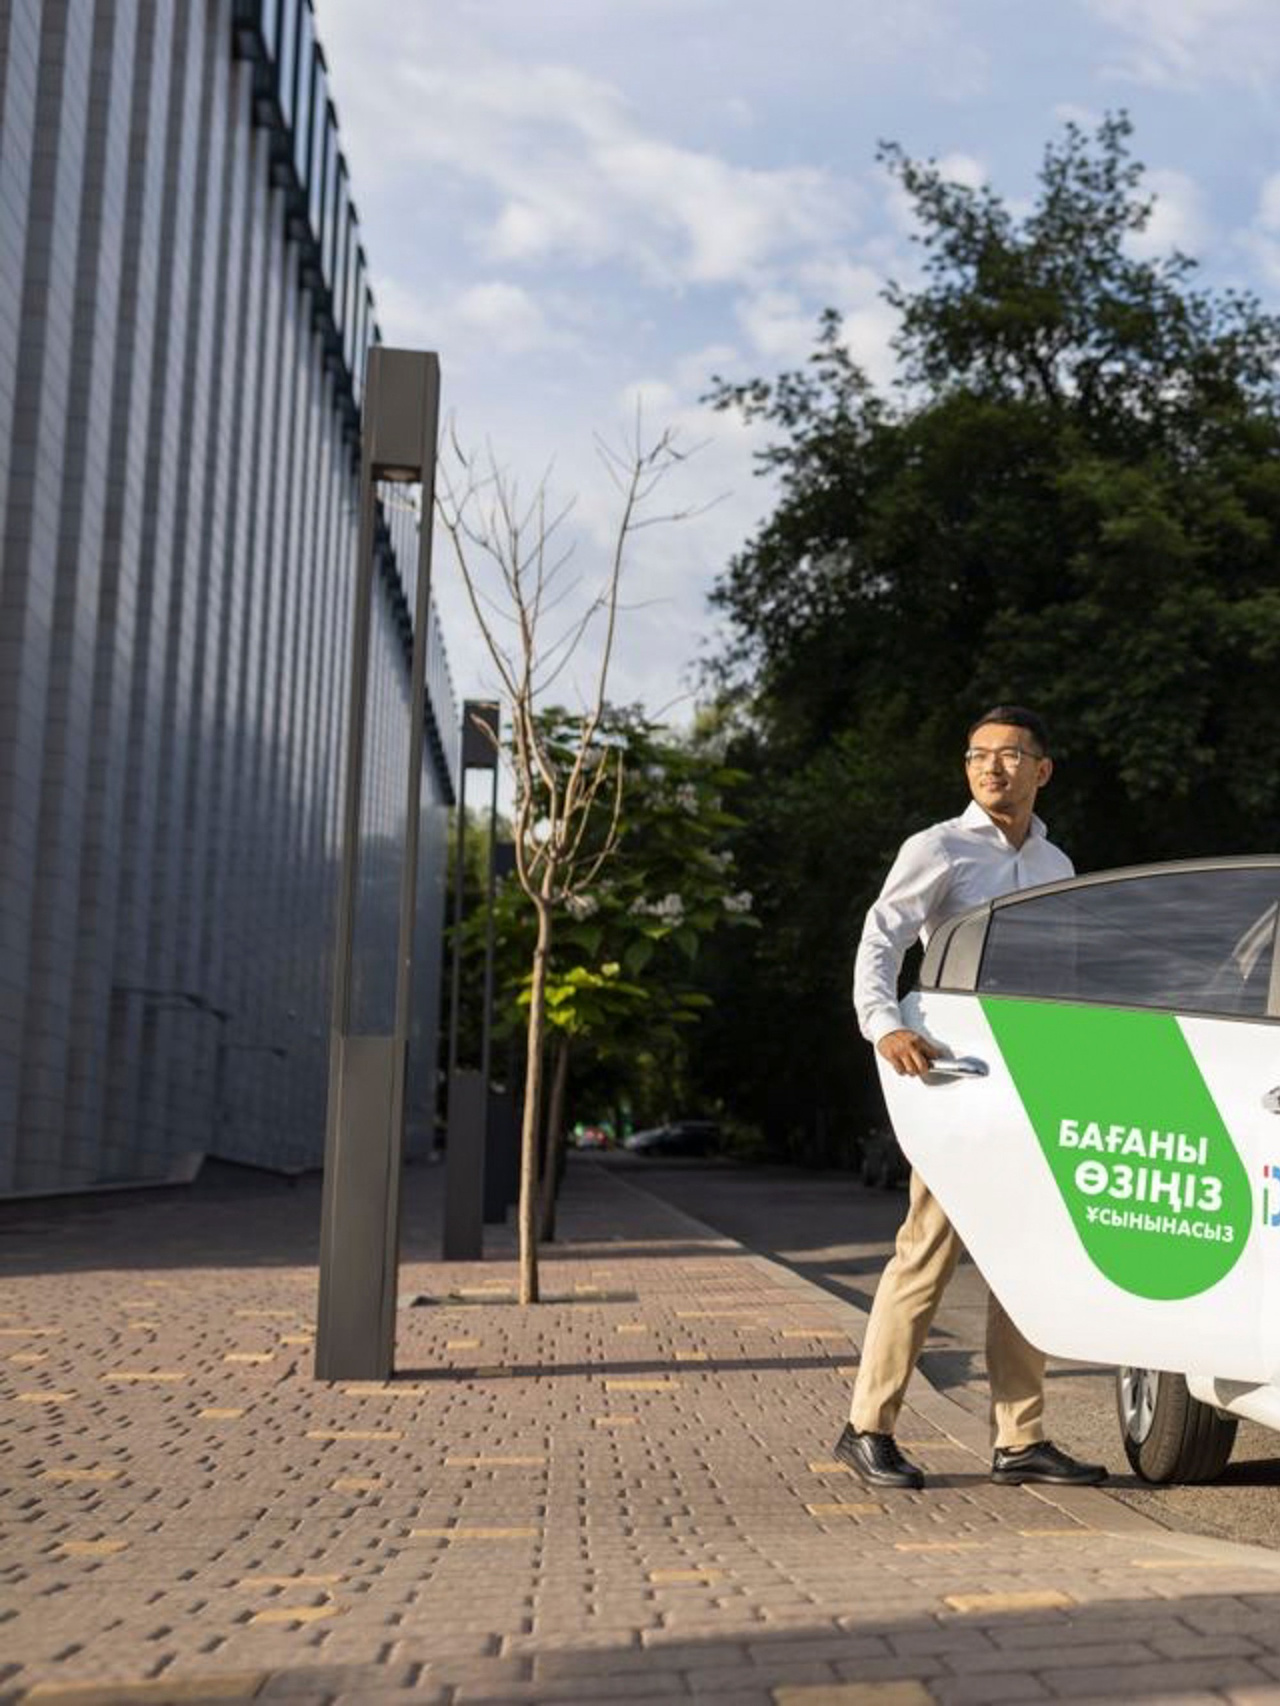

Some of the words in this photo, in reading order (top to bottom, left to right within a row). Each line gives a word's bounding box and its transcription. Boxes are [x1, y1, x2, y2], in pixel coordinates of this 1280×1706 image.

[1058, 1119, 1208, 1165] БАҒАНЫ
[1075, 1160, 1223, 1213] ӨЗІҢІЗ
[1086, 1206, 1234, 1242] ҰСЫНЫНАСЫЗ
